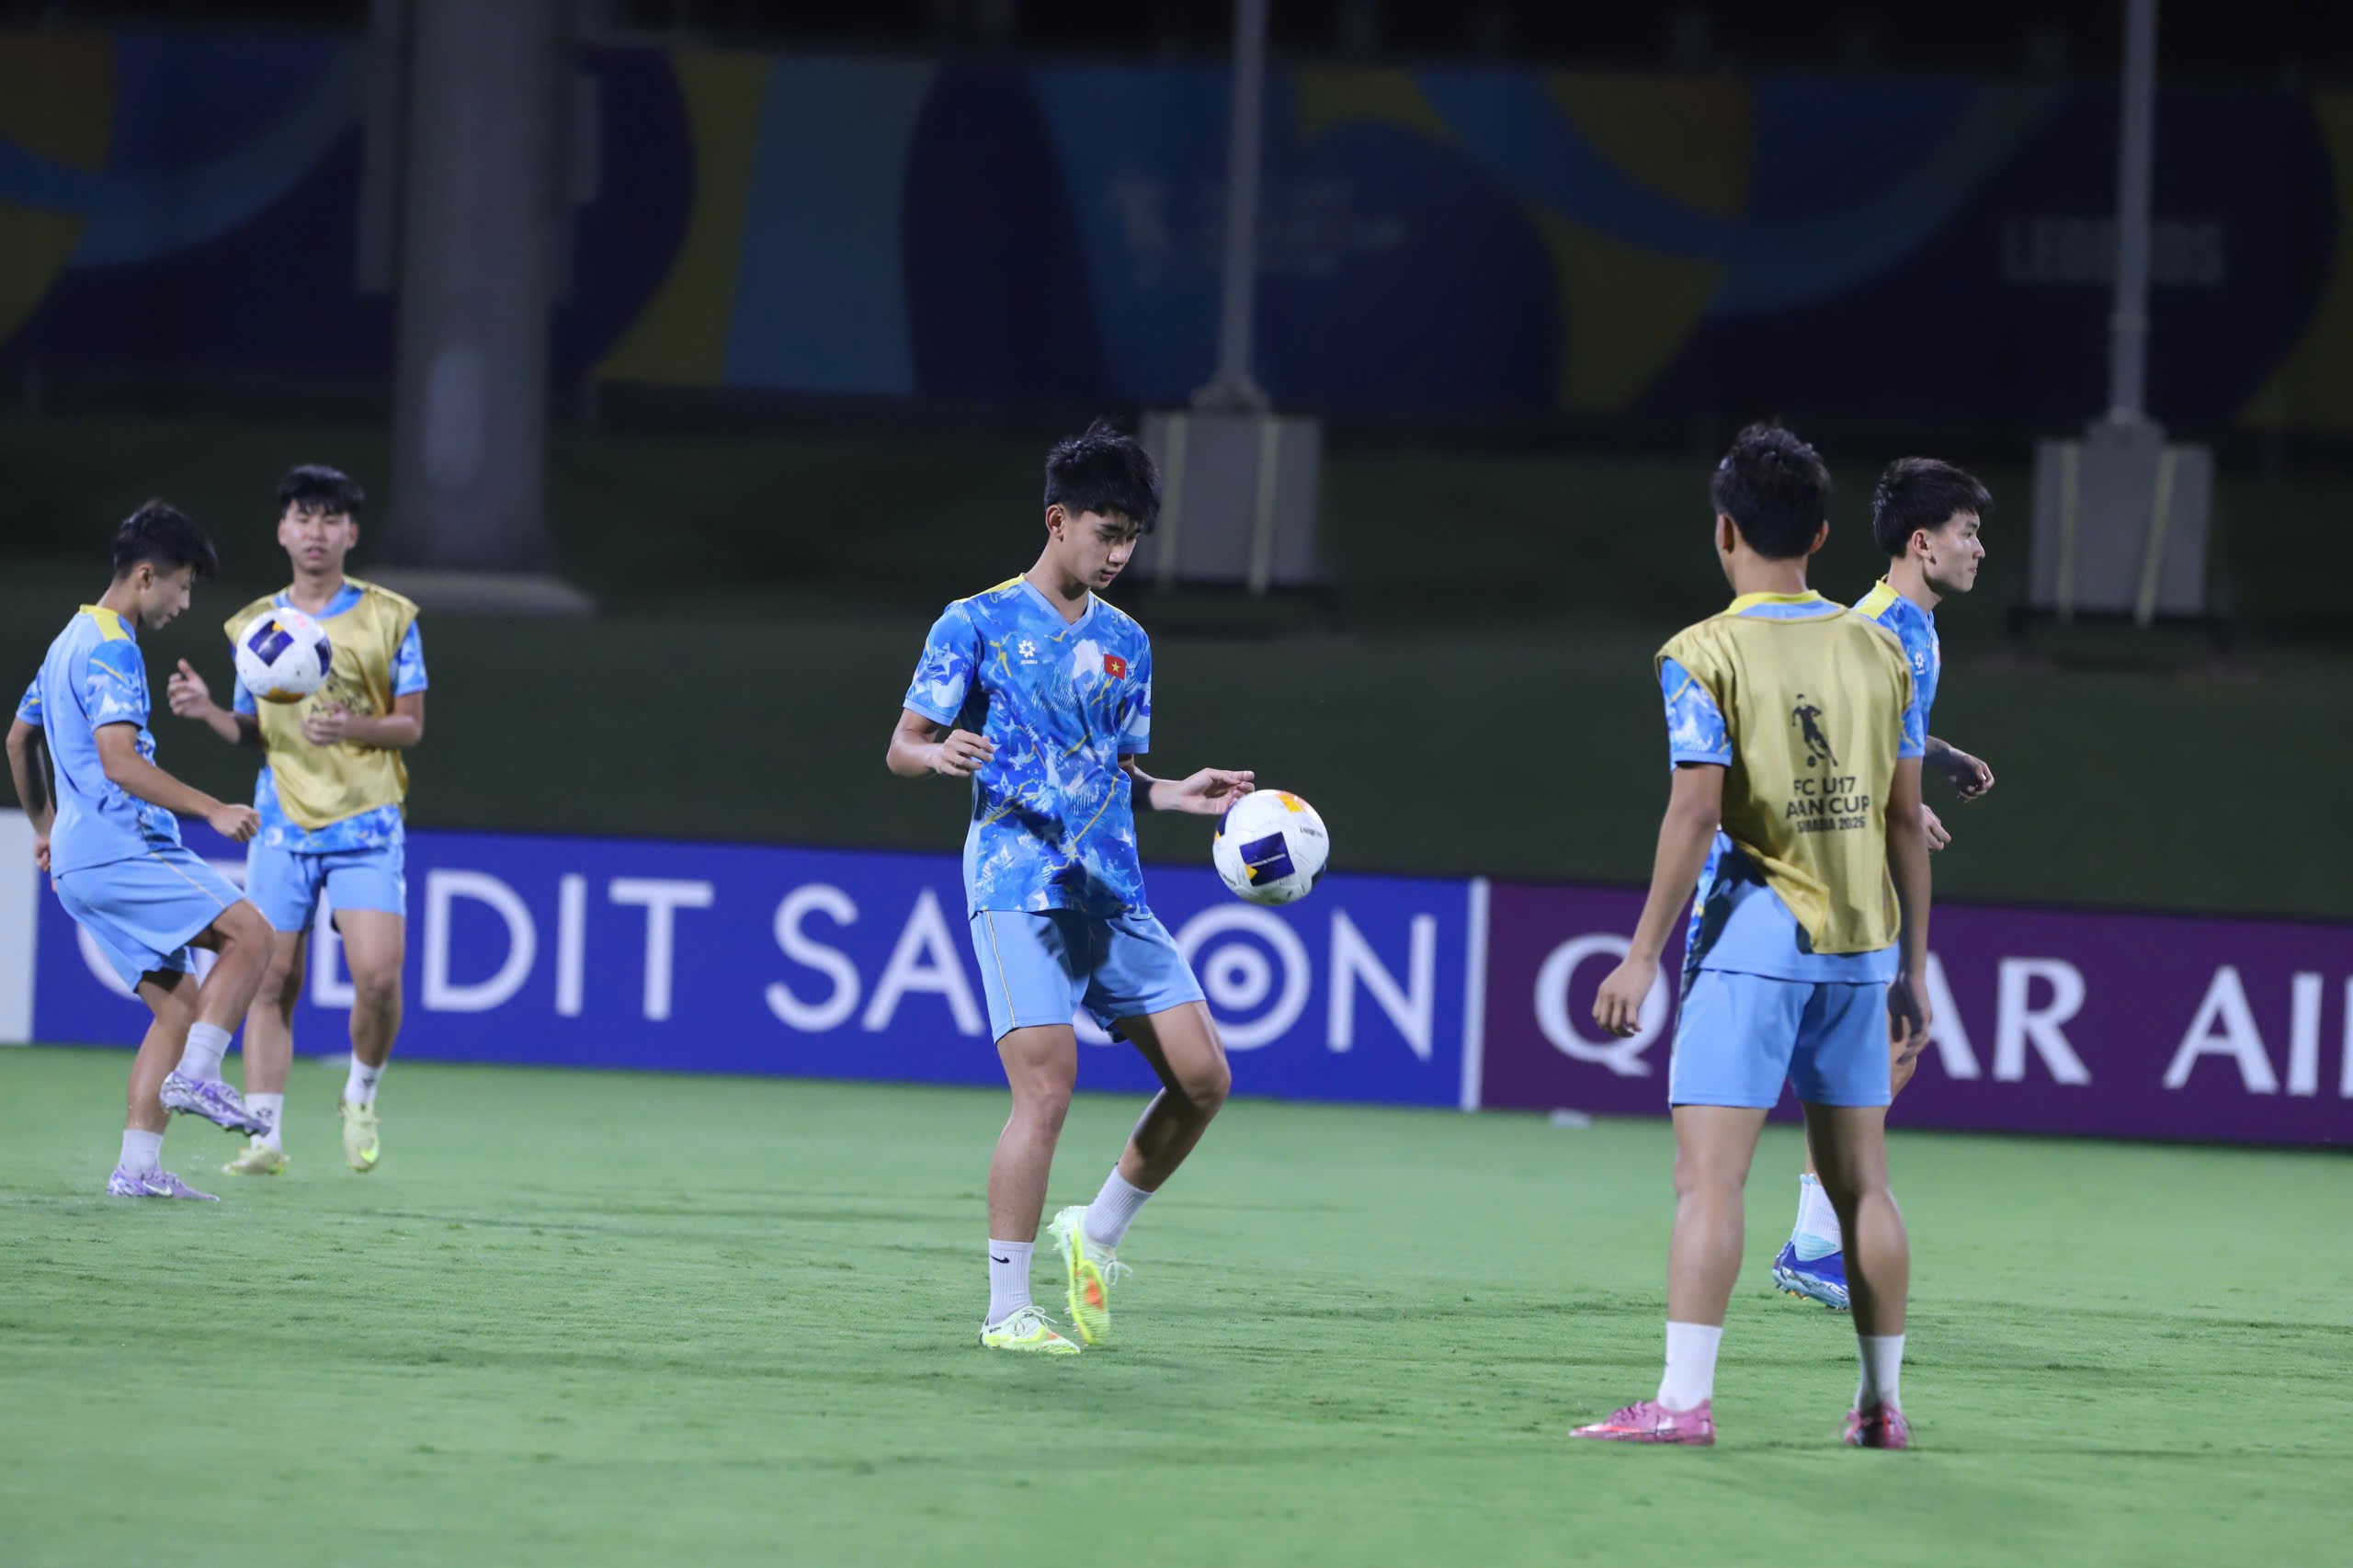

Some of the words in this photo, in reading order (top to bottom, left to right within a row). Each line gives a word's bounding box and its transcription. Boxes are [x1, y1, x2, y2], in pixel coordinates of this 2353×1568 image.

[1822, 777, 1856, 794] U17
[1829, 795, 1870, 814] CUP
[764, 882, 1437, 1062] SAON
[1533, 933, 2092, 1086] QAR
[2162, 965, 2353, 1098] AI
